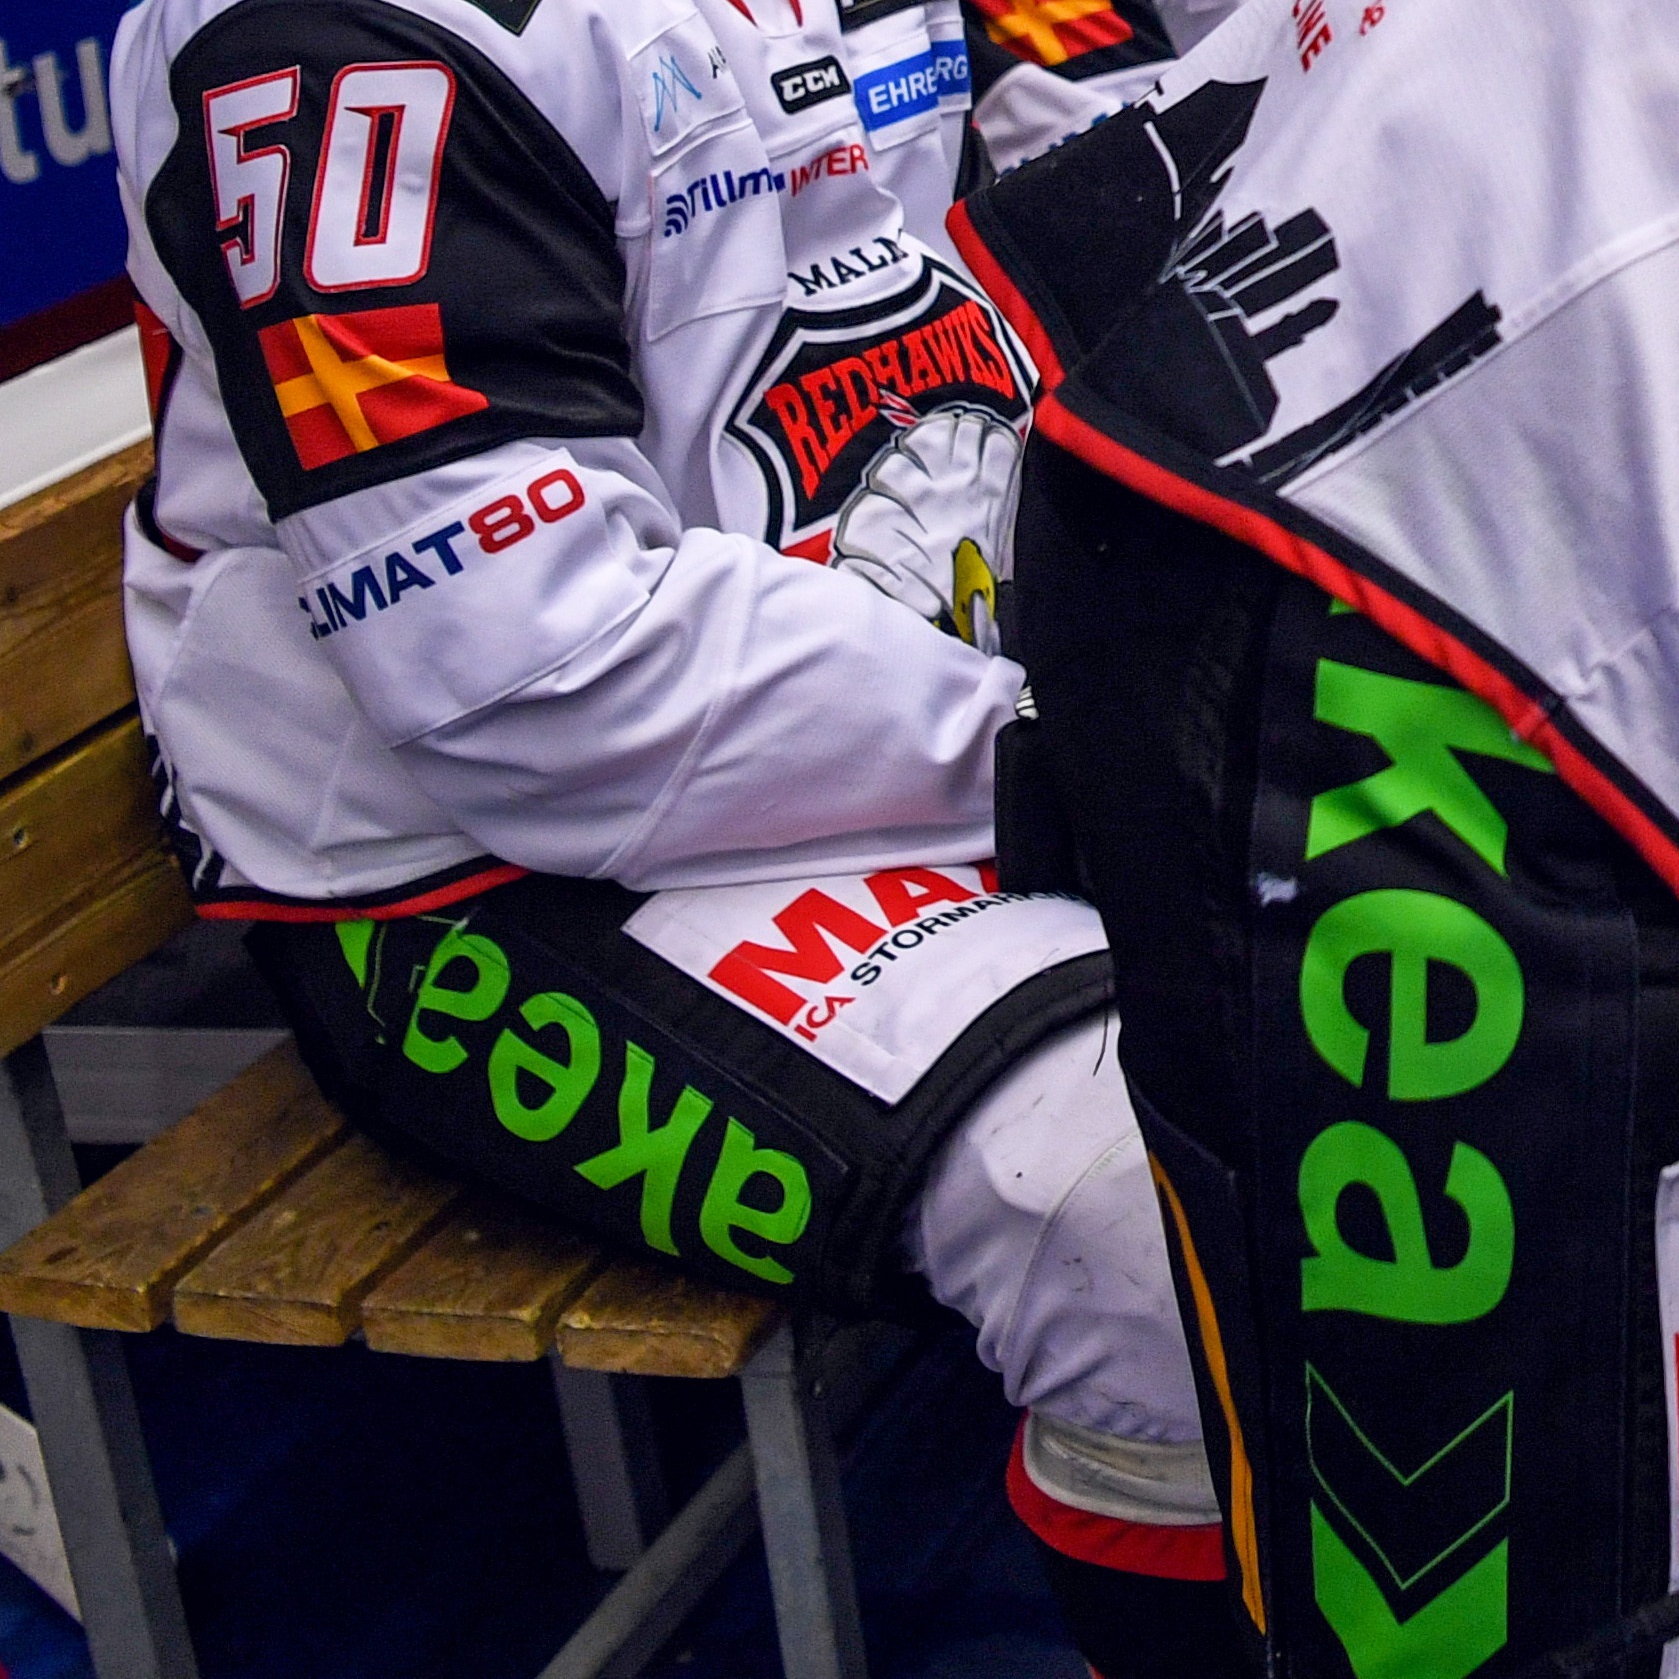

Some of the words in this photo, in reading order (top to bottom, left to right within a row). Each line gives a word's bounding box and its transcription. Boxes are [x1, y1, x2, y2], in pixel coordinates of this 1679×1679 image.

[201, 59, 458, 310] 50
[779, 63, 841, 103] CCM
[763, 300, 1016, 501] REDHAWKS
[794, 994, 857, 1044] ICA
[1299, 621, 1556, 1326] kea
[402, 918, 813, 1286] akea
